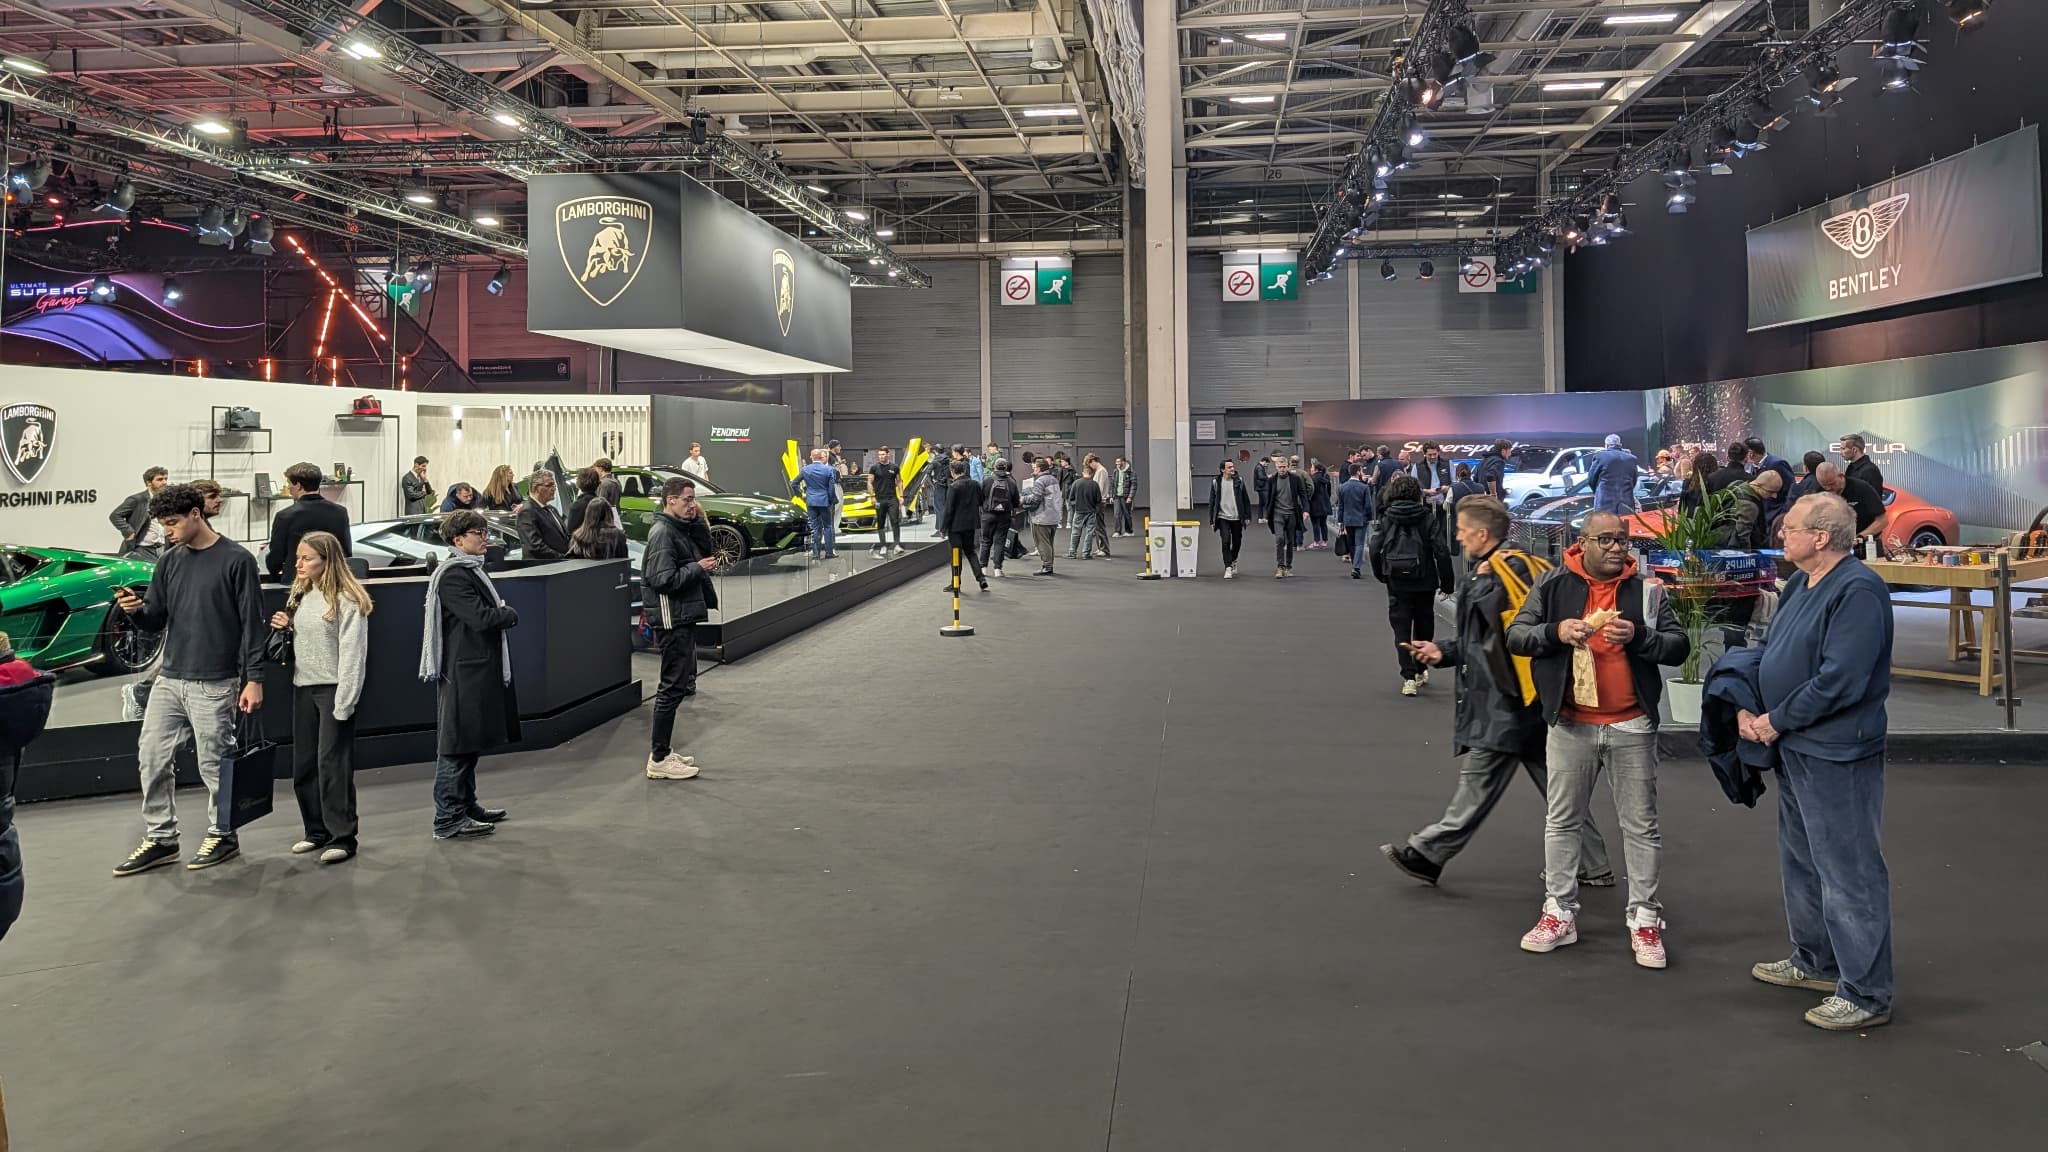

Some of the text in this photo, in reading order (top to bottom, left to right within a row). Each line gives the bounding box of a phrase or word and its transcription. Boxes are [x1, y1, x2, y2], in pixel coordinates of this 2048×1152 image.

[1267, 169, 1282, 180] 26
[562, 201, 647, 222] LAMBORGHINI
[1829, 263, 1902, 300] BENTLEY
[10, 287, 115, 296] SUPERC
[36, 293, 87, 313] Garage
[4, 406, 54, 421] LAMBORGHINI
[0, 489, 97, 508] RGHINI PARIS
